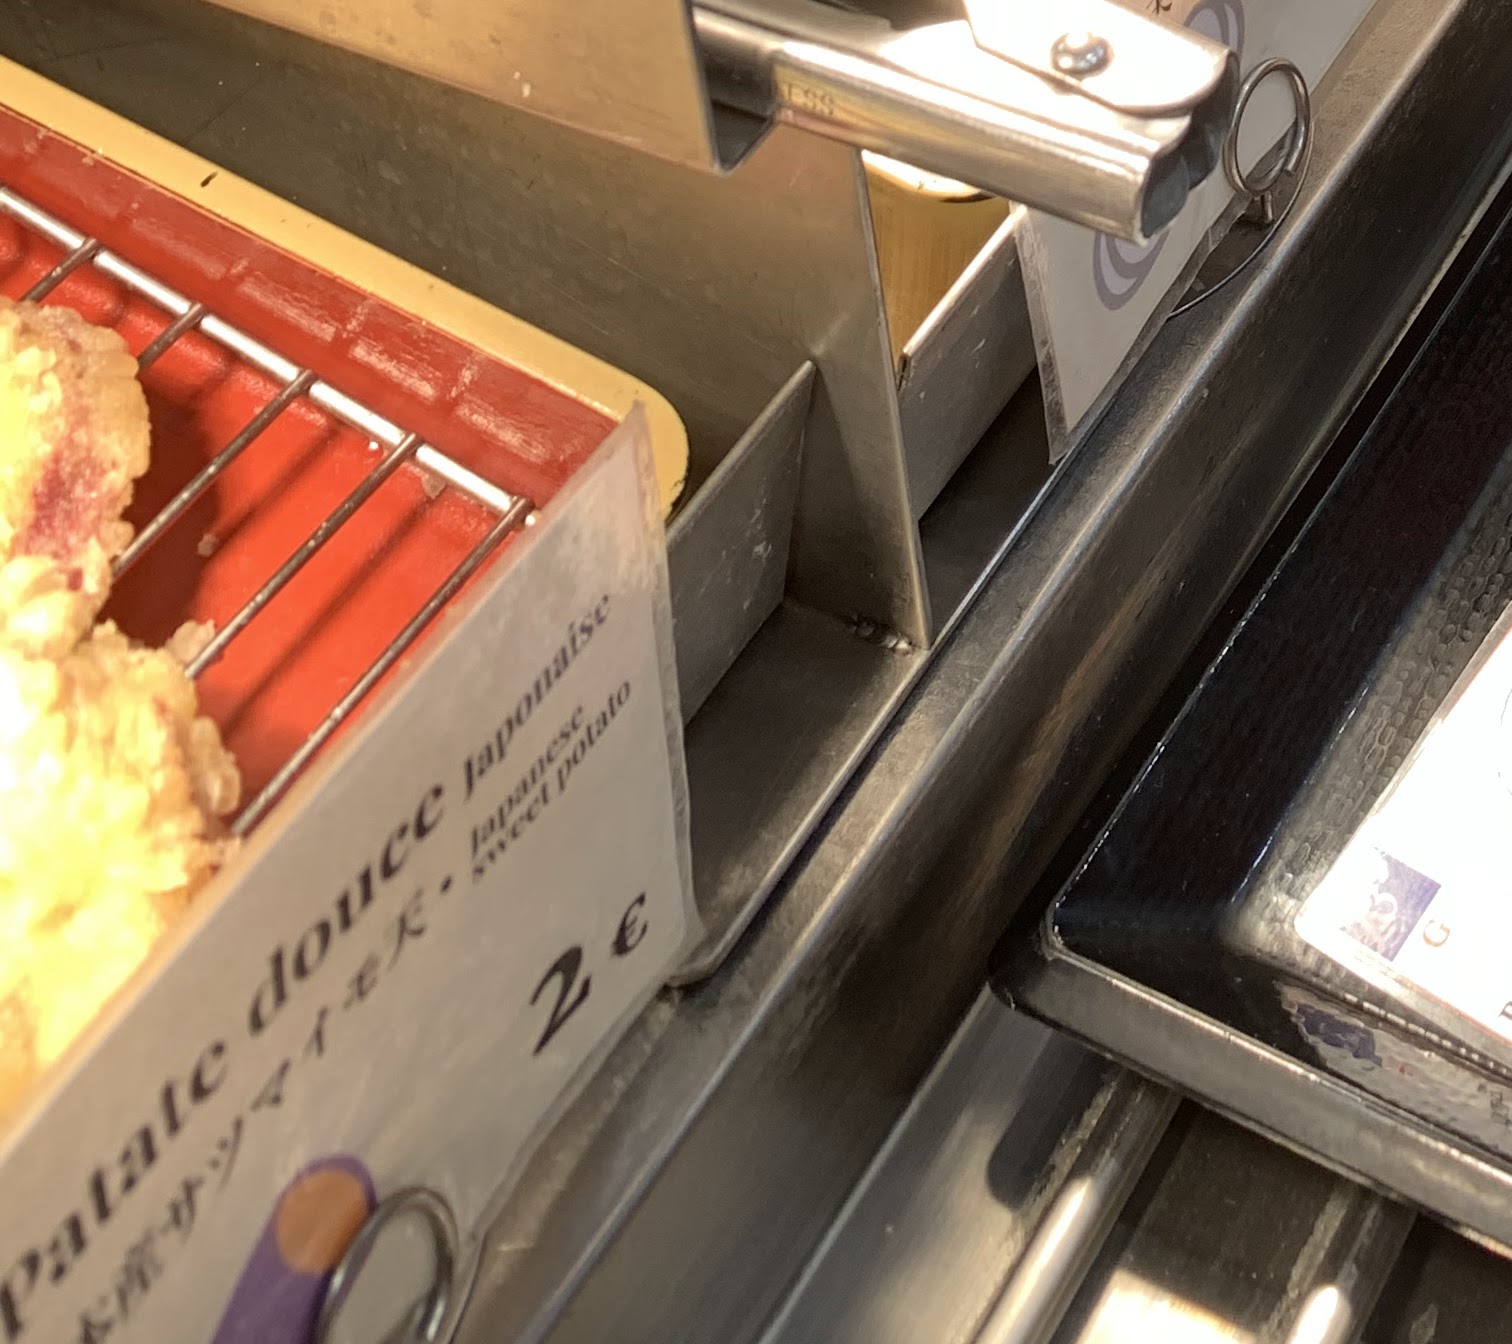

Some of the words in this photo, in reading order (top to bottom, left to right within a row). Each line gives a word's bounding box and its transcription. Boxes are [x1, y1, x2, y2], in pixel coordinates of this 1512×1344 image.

[468, 705, 584, 859] Japanese
[471, 788, 551, 885] sweet
[556, 678, 632, 796] potato
[0, 1040, 228, 1343] Patate
[248, 782, 446, 1038] douce
[462, 594, 611, 803] Japonaise
[529, 944, 593, 1058] 2
[610, 891, 648, 960] €
